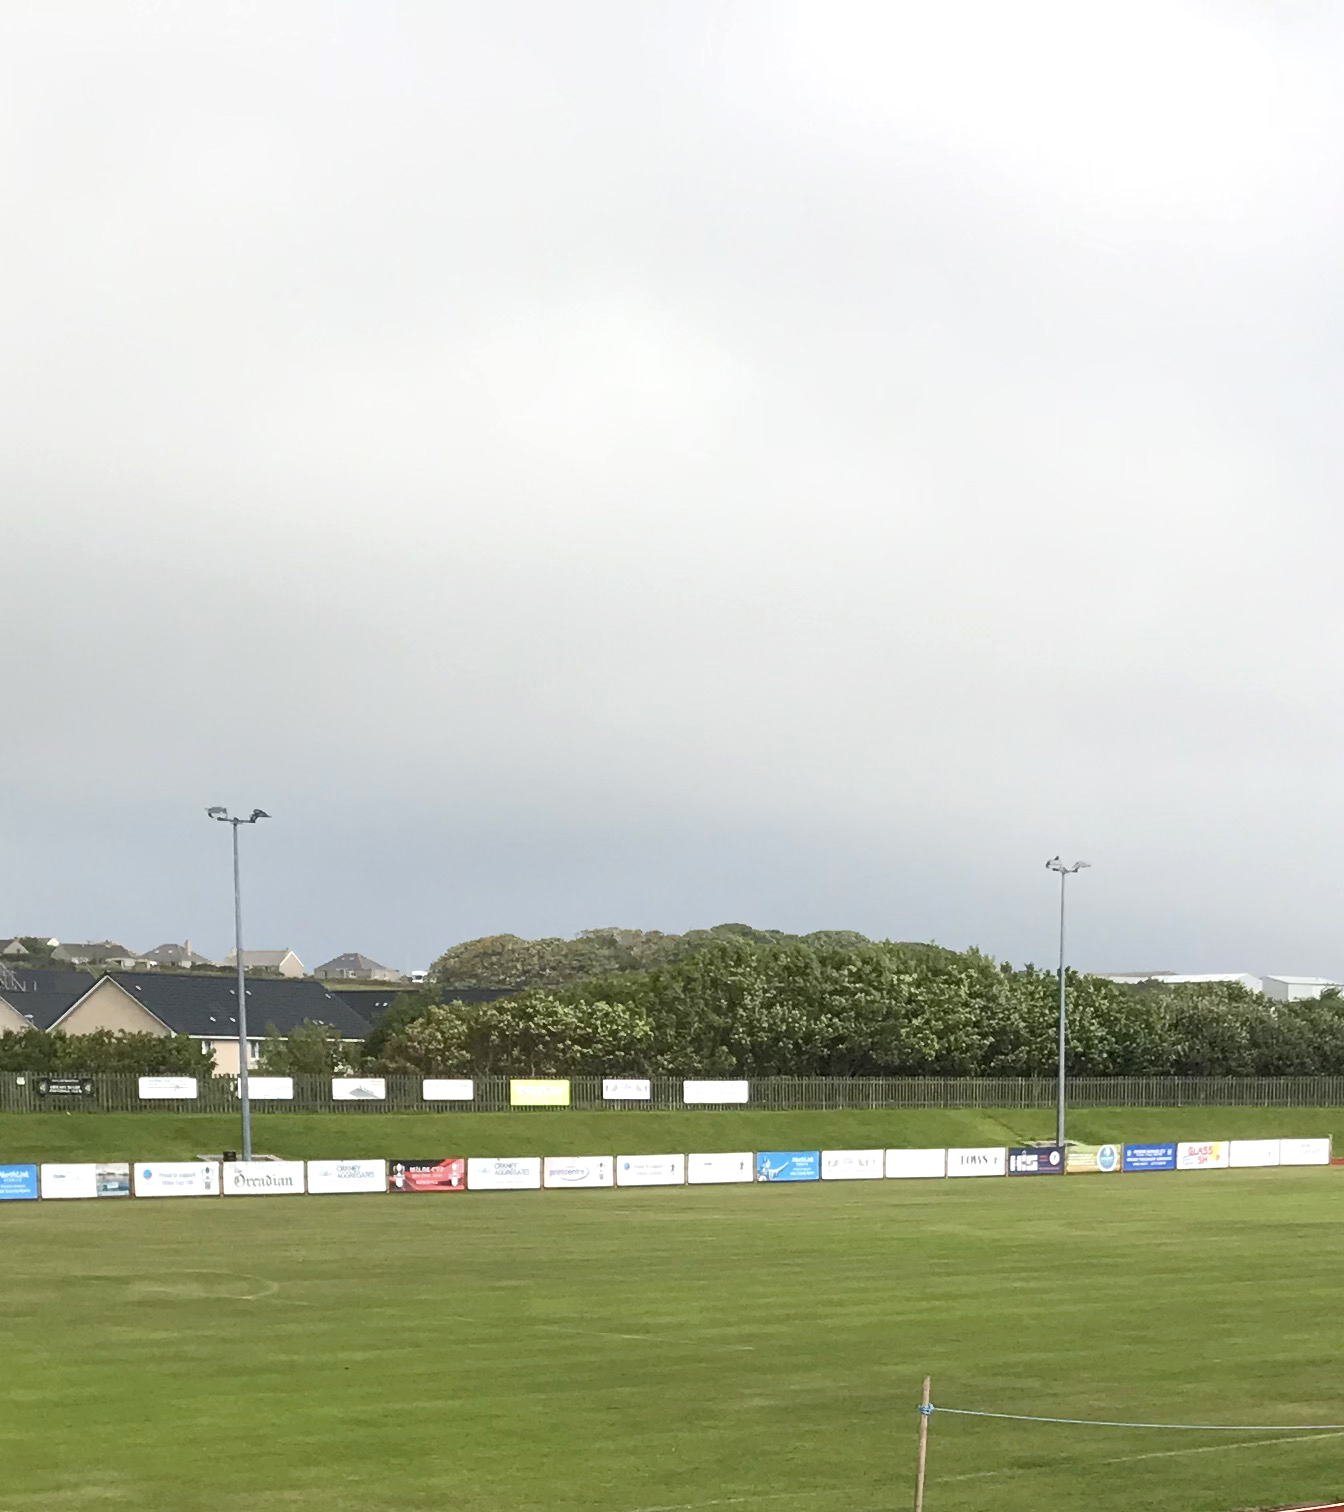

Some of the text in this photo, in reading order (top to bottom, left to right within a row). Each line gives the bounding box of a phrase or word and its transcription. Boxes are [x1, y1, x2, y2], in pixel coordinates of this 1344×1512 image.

[1188, 1146, 1213, 1156] GLASS
[549, 1168, 585, 1177] printcentre
[234, 1173, 294, 1188] Orcadian
